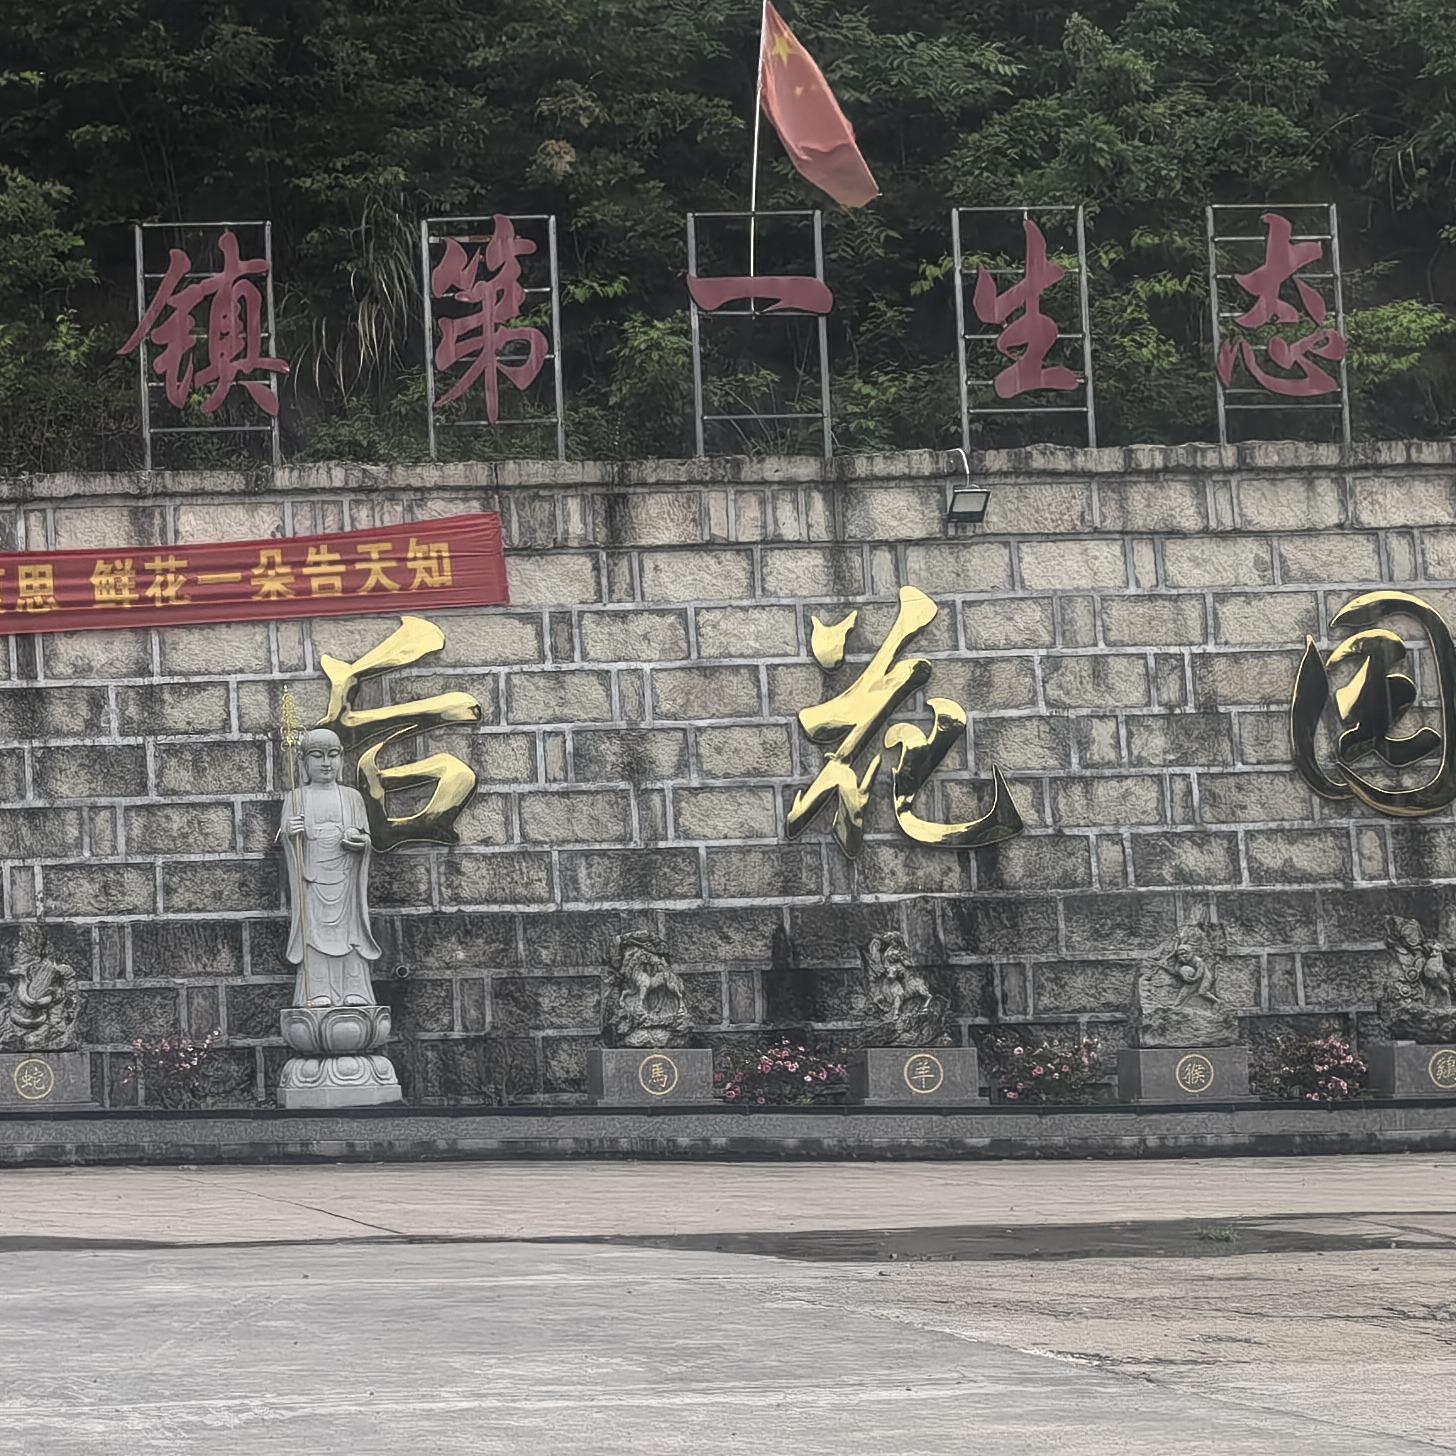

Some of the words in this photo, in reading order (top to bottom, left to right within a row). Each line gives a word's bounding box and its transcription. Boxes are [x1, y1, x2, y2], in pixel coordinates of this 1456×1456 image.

[91, 538, 453, 608] 鲜花一朵告天知
